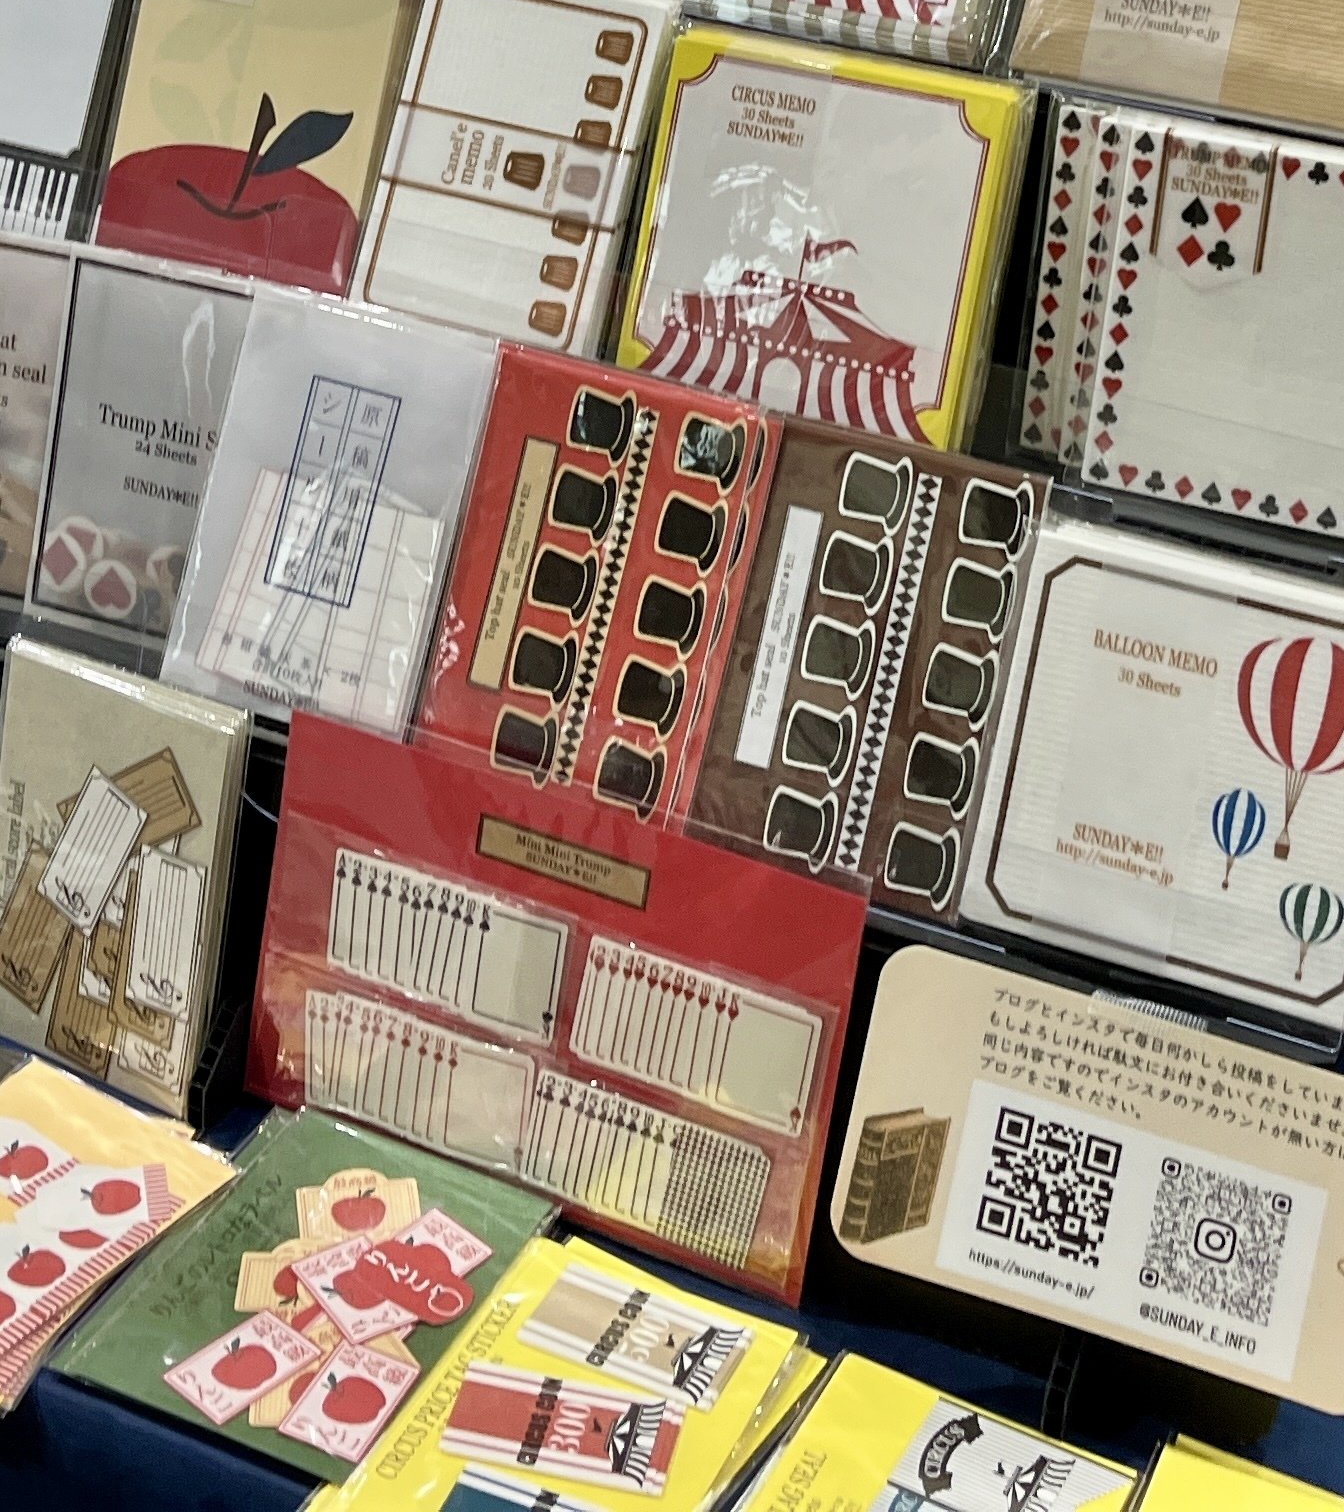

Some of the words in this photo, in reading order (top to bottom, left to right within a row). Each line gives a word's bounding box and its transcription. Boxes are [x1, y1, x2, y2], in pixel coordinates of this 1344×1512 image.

[1104, 7, 1222, 44] http://sunday-e.jp
[730, 83, 776, 109] CIRCUS
[775, 89, 817, 117] MEMO
[741, 106, 756, 123] 30
[757, 109, 796, 131] Sheets
[459, 129, 485, 186] memo
[1185, 163, 1203, 179] 30
[1205, 167, 1248, 187] Sheets
[13, 360, 47, 386] seal
[99, 402, 156, 441] Trump
[160, 417, 202, 448] Mini
[135, 440, 152, 455] 24
[154, 443, 198, 467] Sheets
[484, 614, 505, 642] Top
[1093, 628, 1167, 665] BALLOON
[1168, 648, 1219, 678] MEMO
[1117, 665, 1135, 686] 30
[1136, 671, 1182, 699] Sheets
[11, 780, 27, 822] label
[514, 831, 542, 854] Mini
[543, 838, 573, 861] Mini
[574, 845, 613, 876] Trump
[1056, 838, 1174, 888] http://sunday-e.jp
[979, 1055, 1144, 1121] ブログをご覧ください。
[968, 1247, 1096, 1301] https://sunday-e.jp/
[621, 1315, 672, 1364] 500
[375, 1421, 425, 1481] CIRCUS
[422, 1381, 457, 1426] PRICE
[469, 1297, 523, 1363] STICKER
[549, 1399, 593, 1455] 300
[791, 1450, 829, 1489] SEAL
